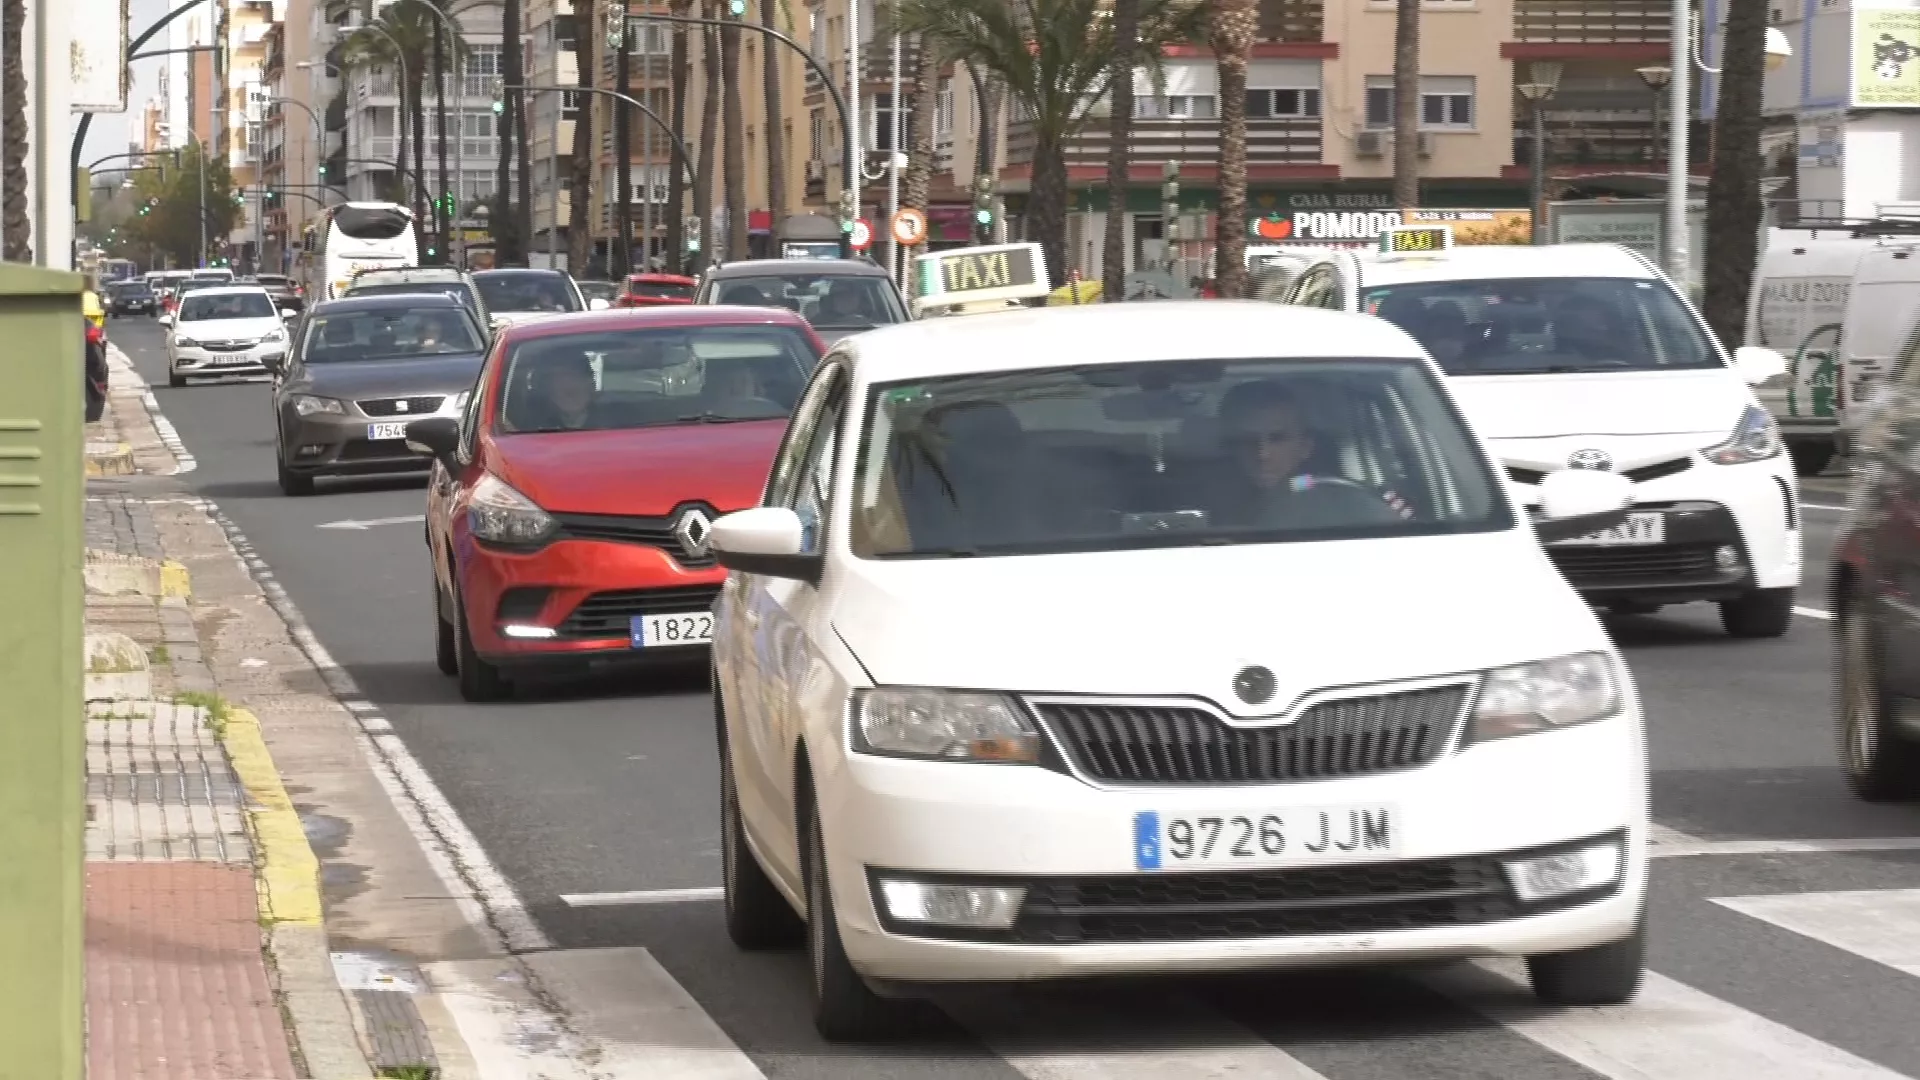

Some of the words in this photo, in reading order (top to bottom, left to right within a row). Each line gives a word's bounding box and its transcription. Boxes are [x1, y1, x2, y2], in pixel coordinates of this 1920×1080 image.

[1289, 193, 1331, 207] CAJA
[1335, 193, 1393, 207] RURAL
[1412, 213, 1441, 221] PLAZA
[1443, 213, 1457, 221] LA
[1393, 231, 1435, 250] TAXI
[941, 252, 1011, 289] TAXI
[1764, 281, 1810, 303] MAJU
[652, 617, 712, 641] 1822
[1167, 814, 1286, 860] 9726
[1303, 806, 1391, 853] JJM
